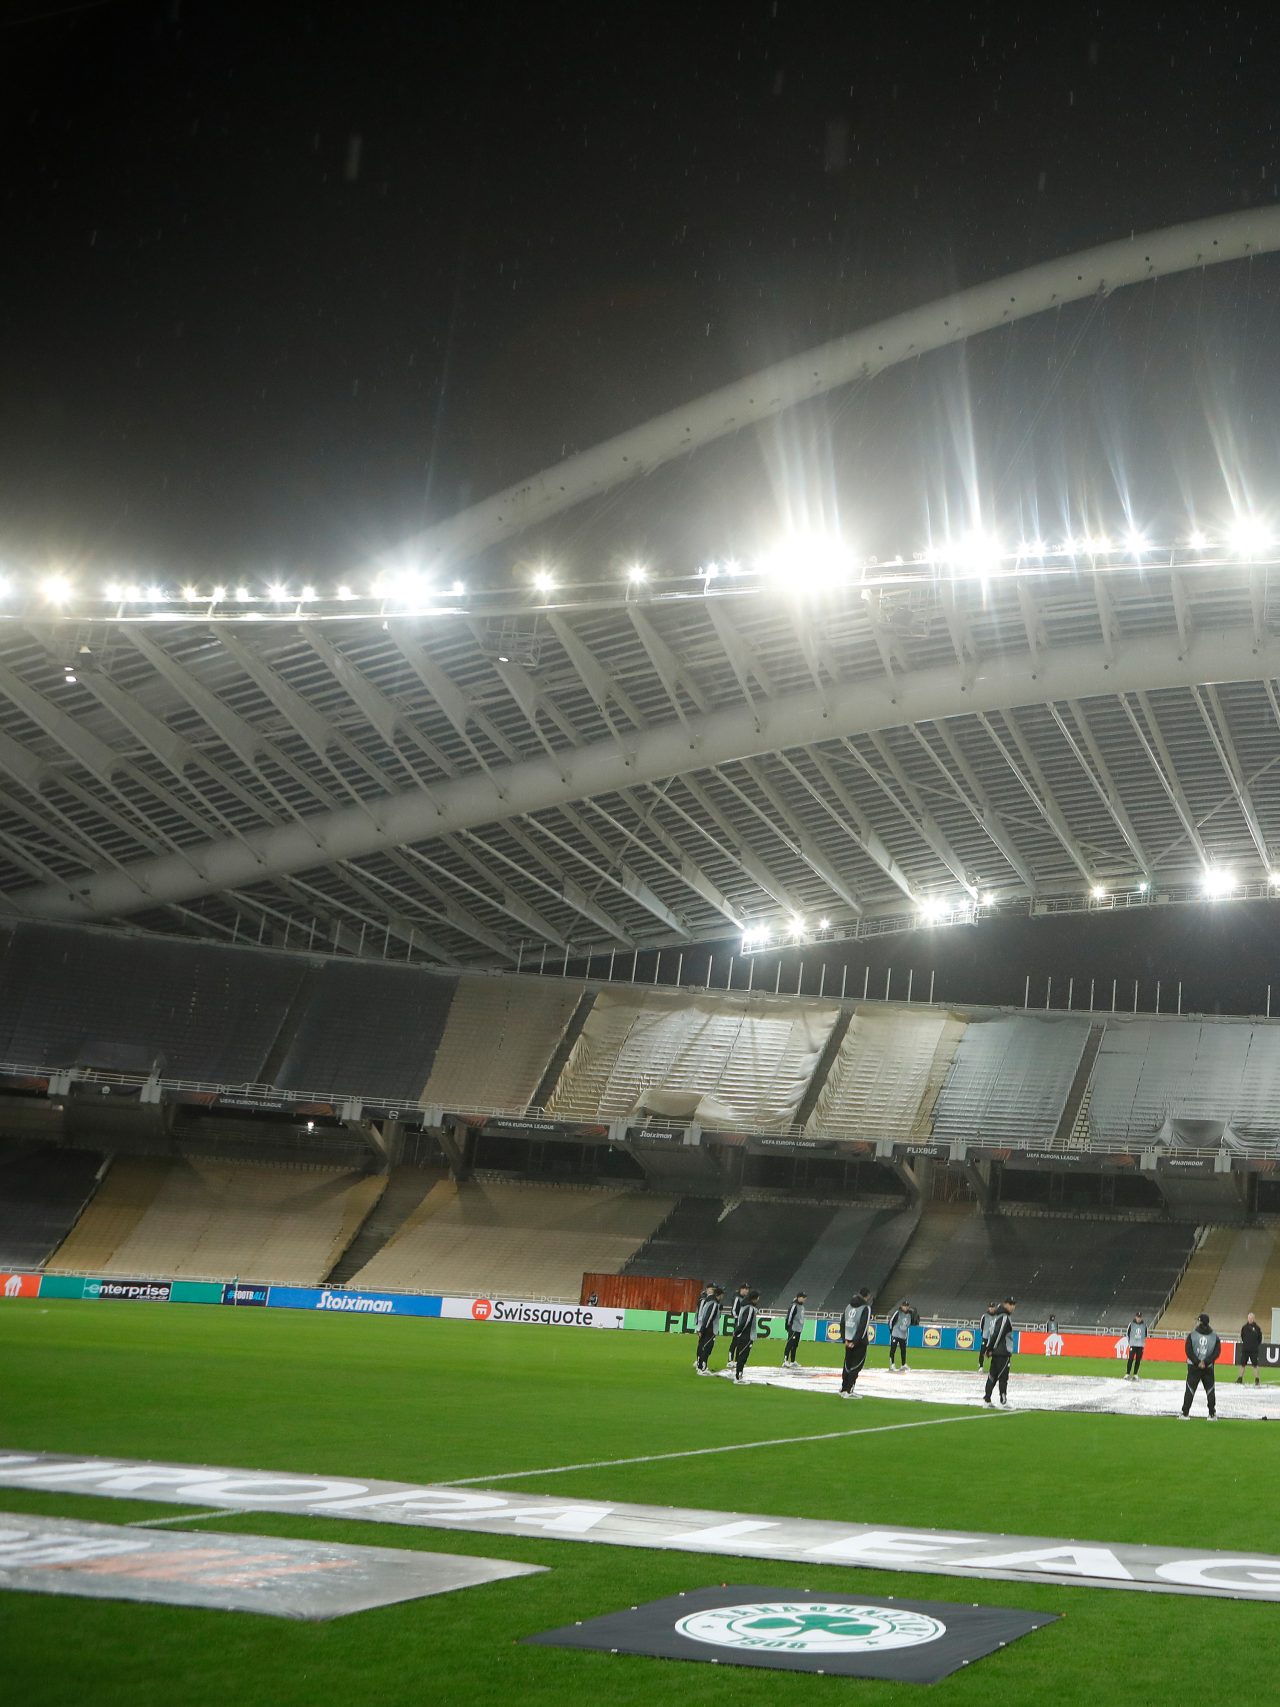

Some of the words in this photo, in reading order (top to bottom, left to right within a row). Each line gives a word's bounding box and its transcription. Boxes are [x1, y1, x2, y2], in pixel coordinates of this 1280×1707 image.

[639, 1130, 672, 1140] Stoiximan
[906, 1146, 938, 1155] FLIXBUS
[90, 1284, 169, 1297] enterprise
[227, 1290, 265, 1300] #FOOTBALL
[316, 1291, 393, 1312] Stoiximan
[493, 1301, 593, 1325] Swissquote
[665, 1311, 771, 1338] FLBS
[727, 1637, 808, 1649] 1908
